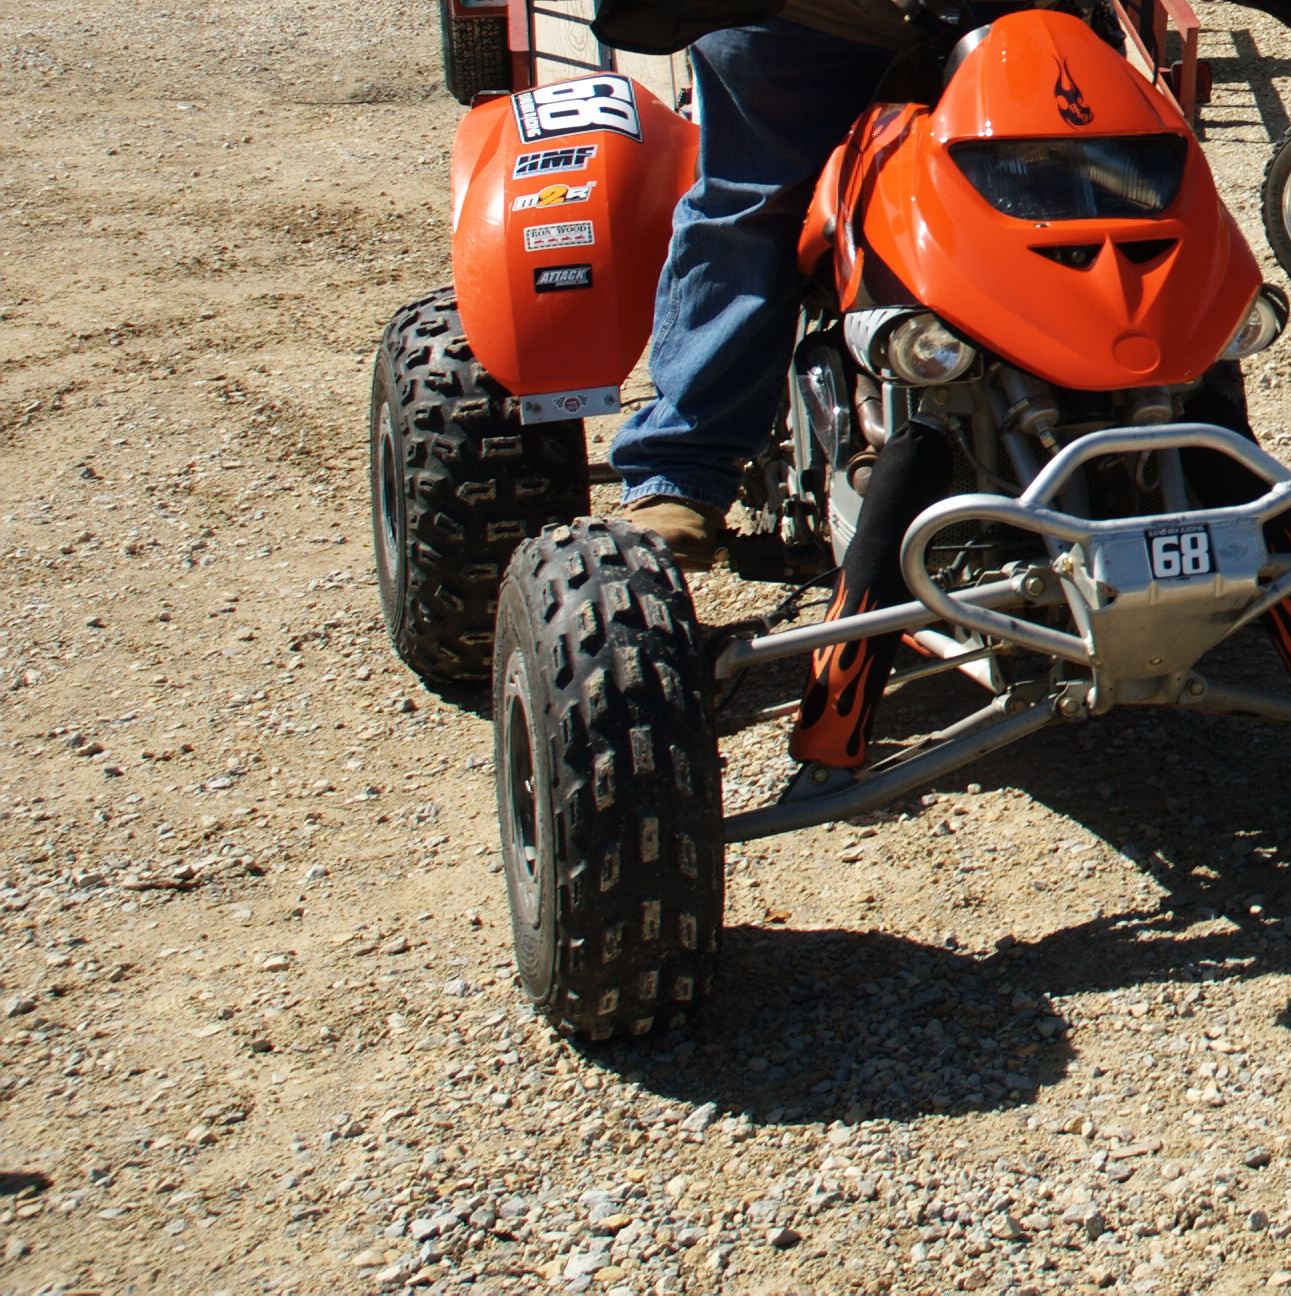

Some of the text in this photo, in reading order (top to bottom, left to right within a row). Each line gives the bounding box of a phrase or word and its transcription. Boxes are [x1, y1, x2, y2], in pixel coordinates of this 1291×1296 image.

[533, 75, 640, 131] 68
[515, 146, 595, 174] HMF
[538, 268, 590, 284] ATTACK
[1152, 532, 1211, 579] 68
